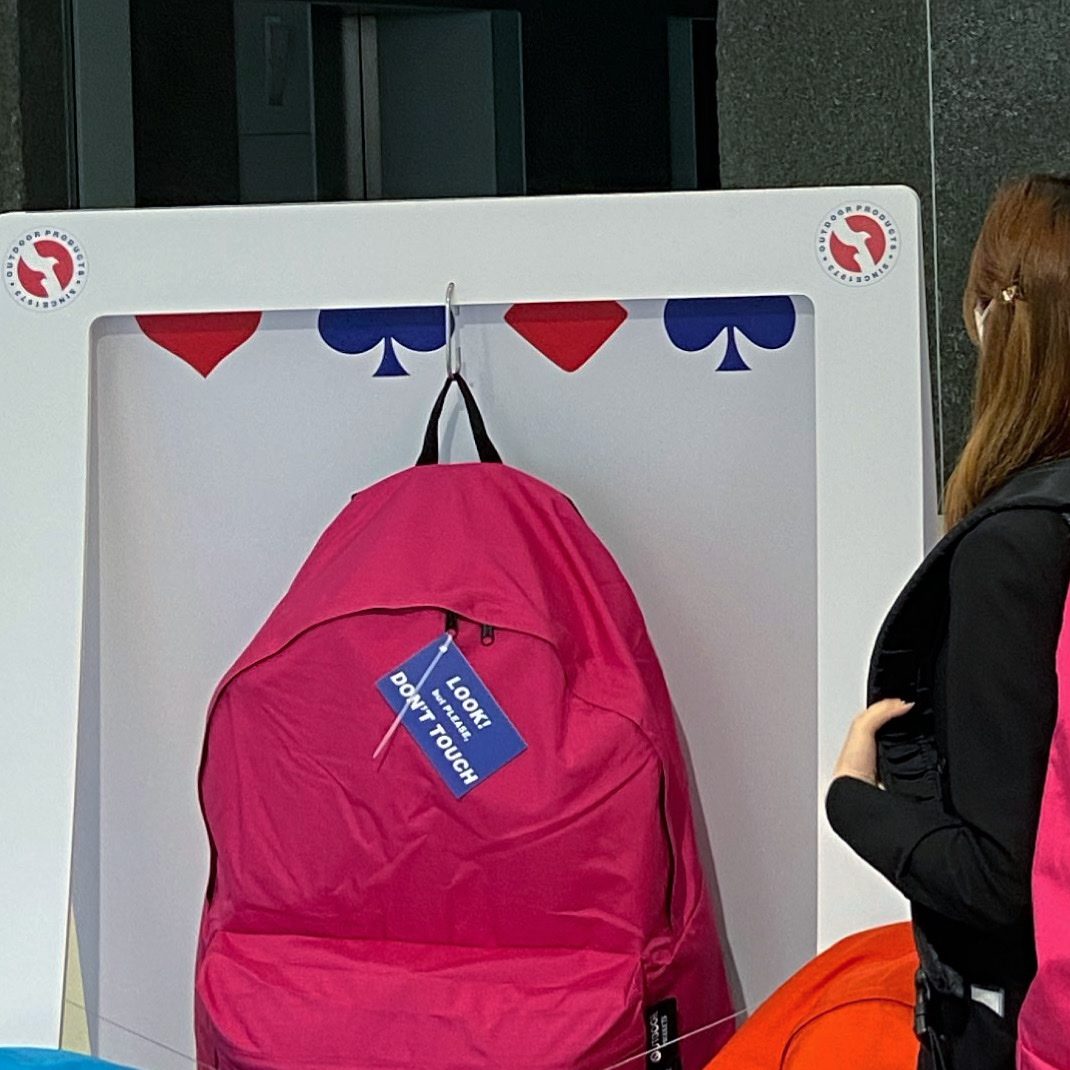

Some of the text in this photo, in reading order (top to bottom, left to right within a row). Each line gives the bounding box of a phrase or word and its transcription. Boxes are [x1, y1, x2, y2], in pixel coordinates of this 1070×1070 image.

[819, 205, 897, 252] OUTDOOR PRODUCTS
[7, 230, 85, 277] OUTDOOR PRODUCTS
[443, 704, 472, 742] PLEASE,
[446, 676, 492, 729] LOOK!
[390, 671, 479, 785] DON'T TOUCH
